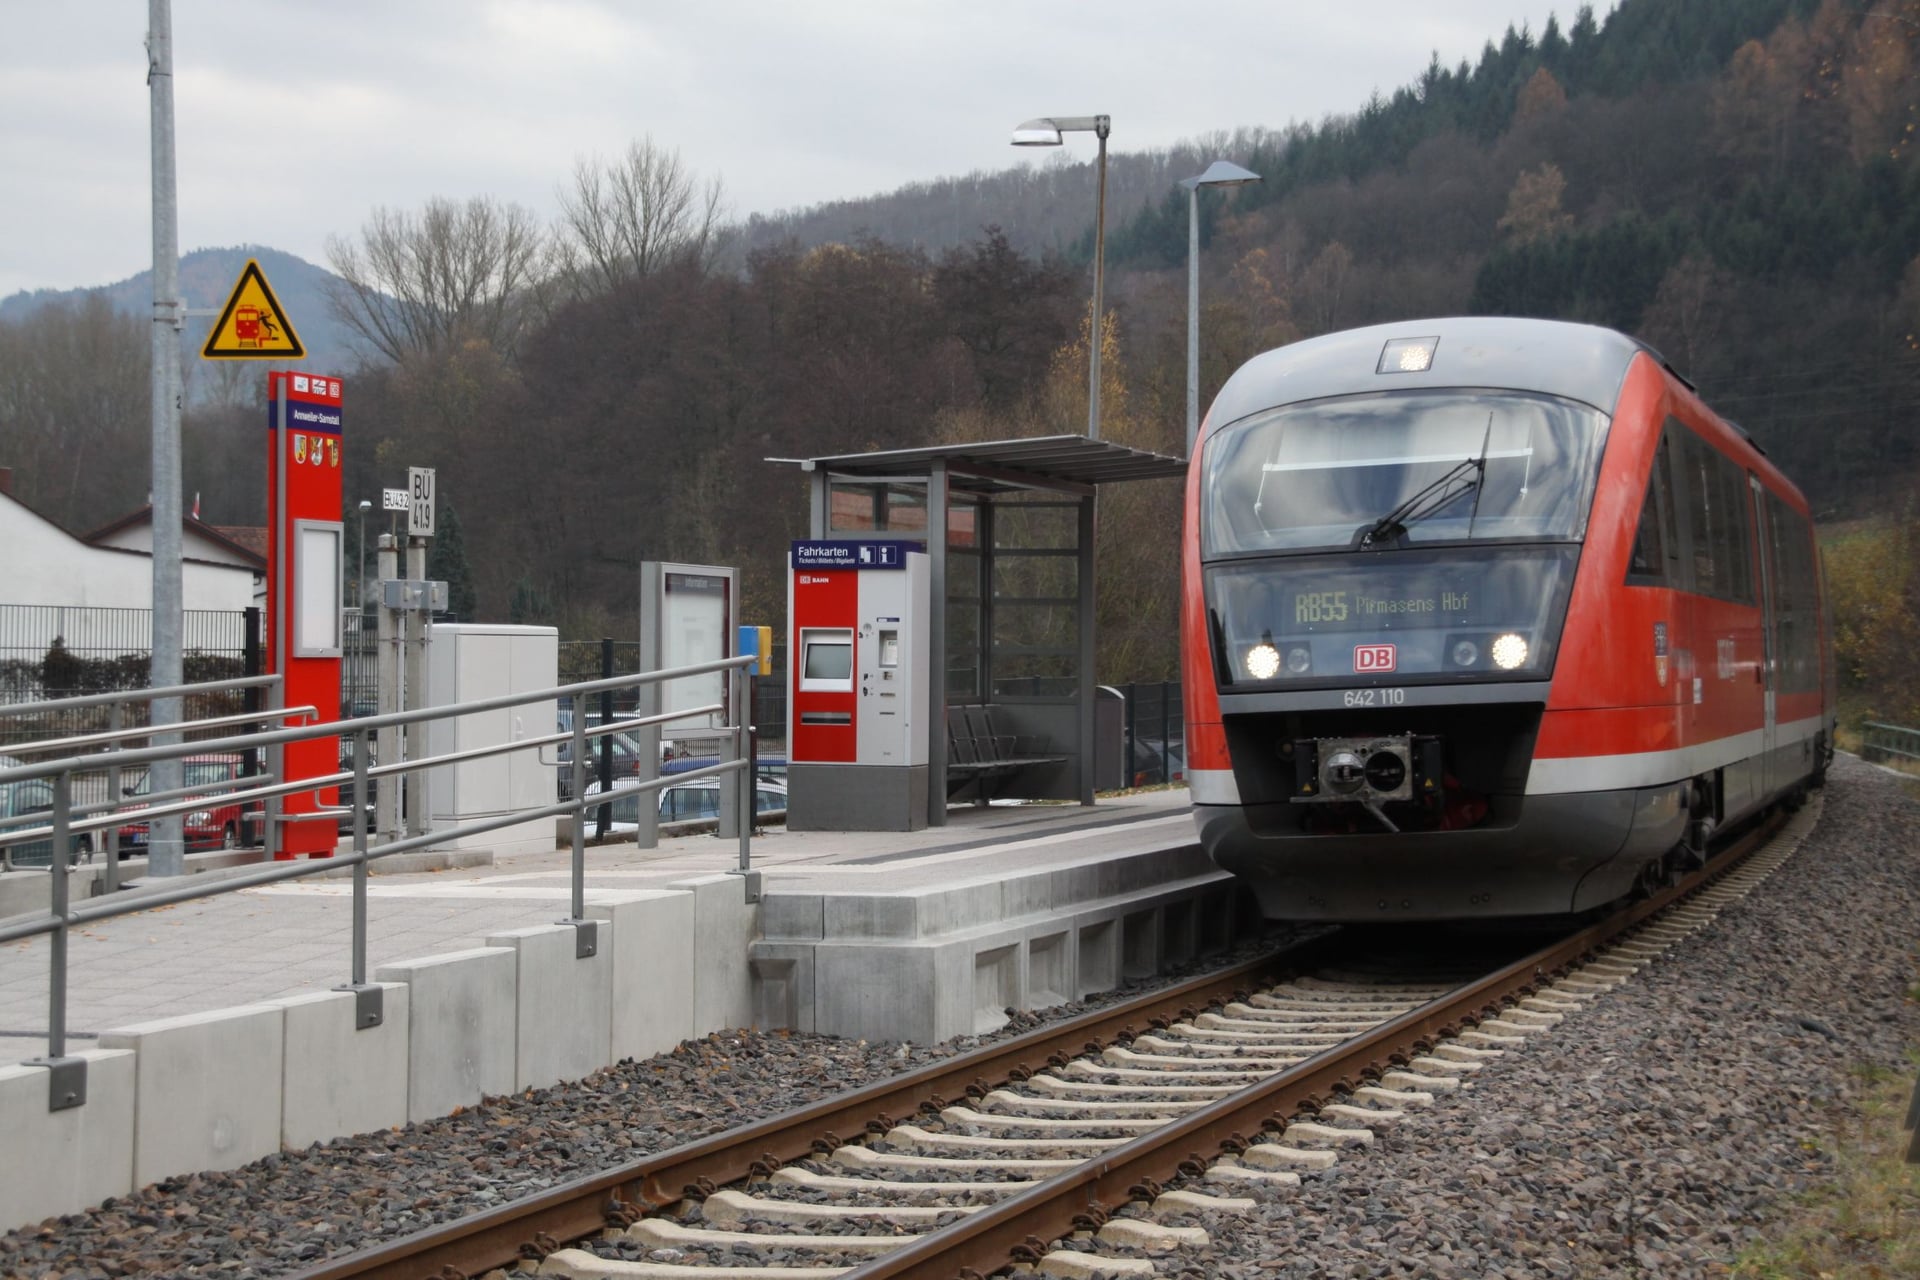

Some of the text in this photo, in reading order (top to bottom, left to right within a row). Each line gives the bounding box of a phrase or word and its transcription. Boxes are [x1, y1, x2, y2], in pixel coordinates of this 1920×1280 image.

[414, 469, 431, 500] BÜ
[798, 546, 848, 557] Fahrkarten
[1295, 591, 1469, 624] RB55 Pirmasens Hbf
[1359, 649, 1391, 668] DB
[1344, 688, 1405, 707] 642 110
